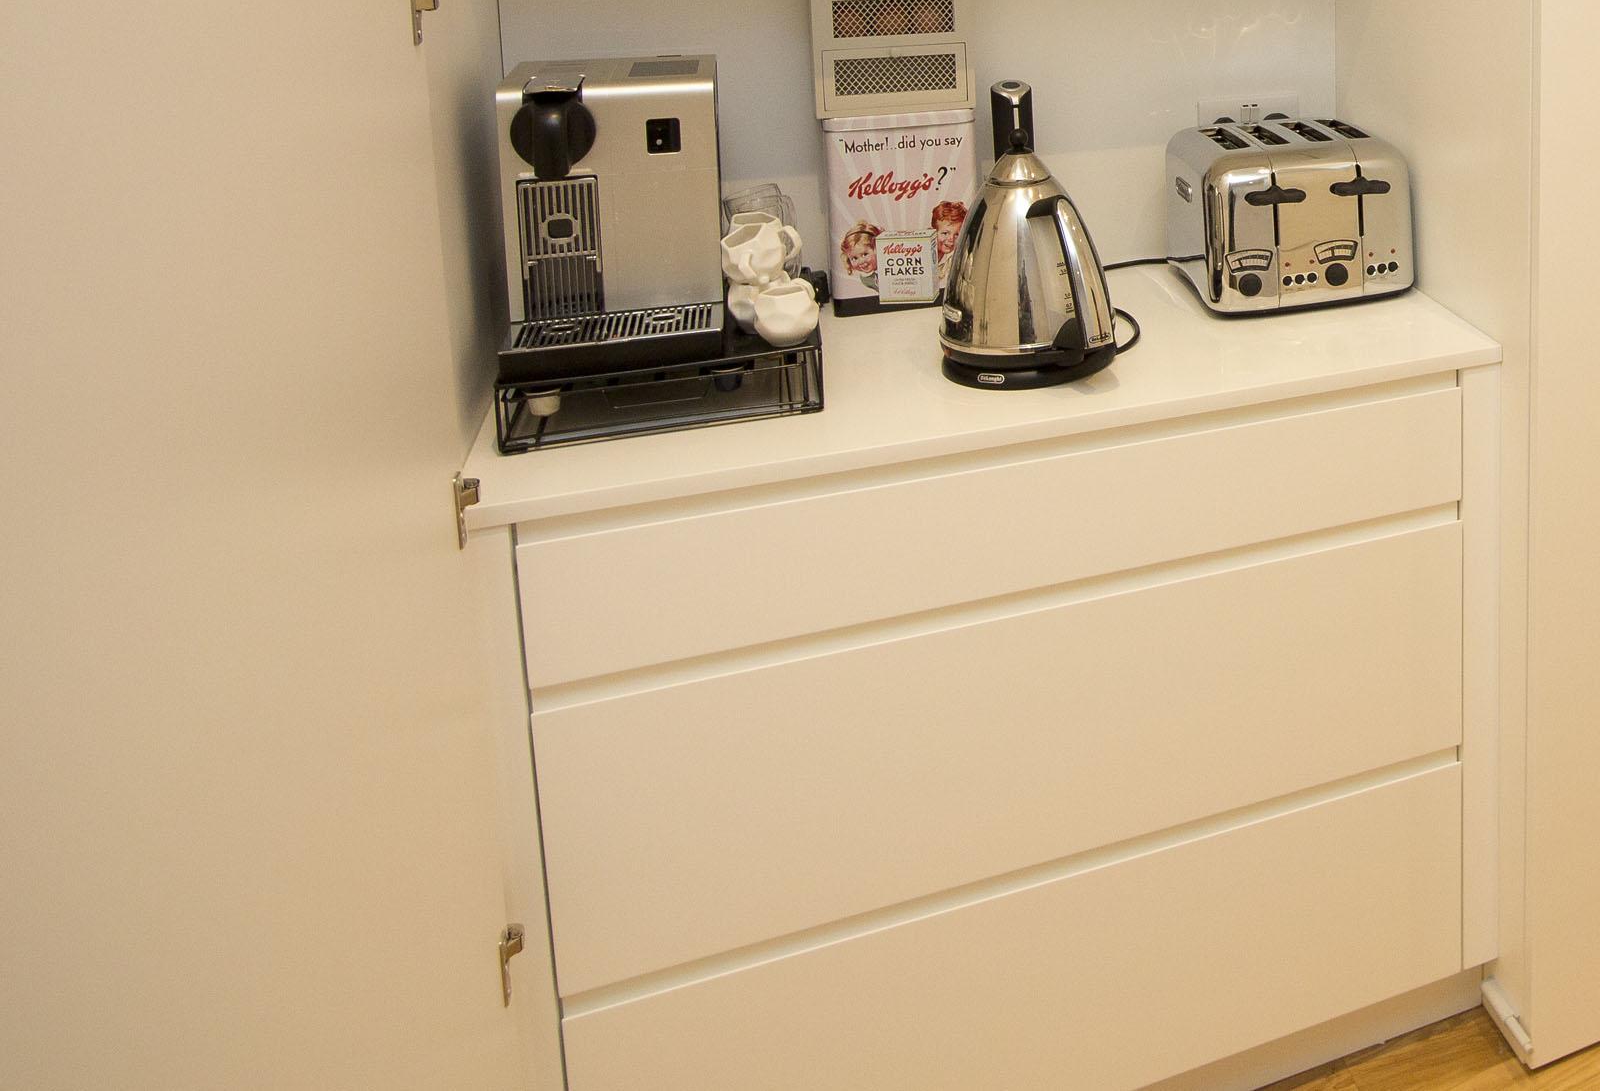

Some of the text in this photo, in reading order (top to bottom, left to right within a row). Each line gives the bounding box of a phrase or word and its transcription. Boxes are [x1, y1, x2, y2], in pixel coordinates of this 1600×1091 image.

[920, 138, 941, 150] you
[944, 136, 963, 148] say
[882, 242, 923, 257] Kellogg's
[886, 257, 922, 267] CORN
[884, 266, 925, 277] FLAKES
